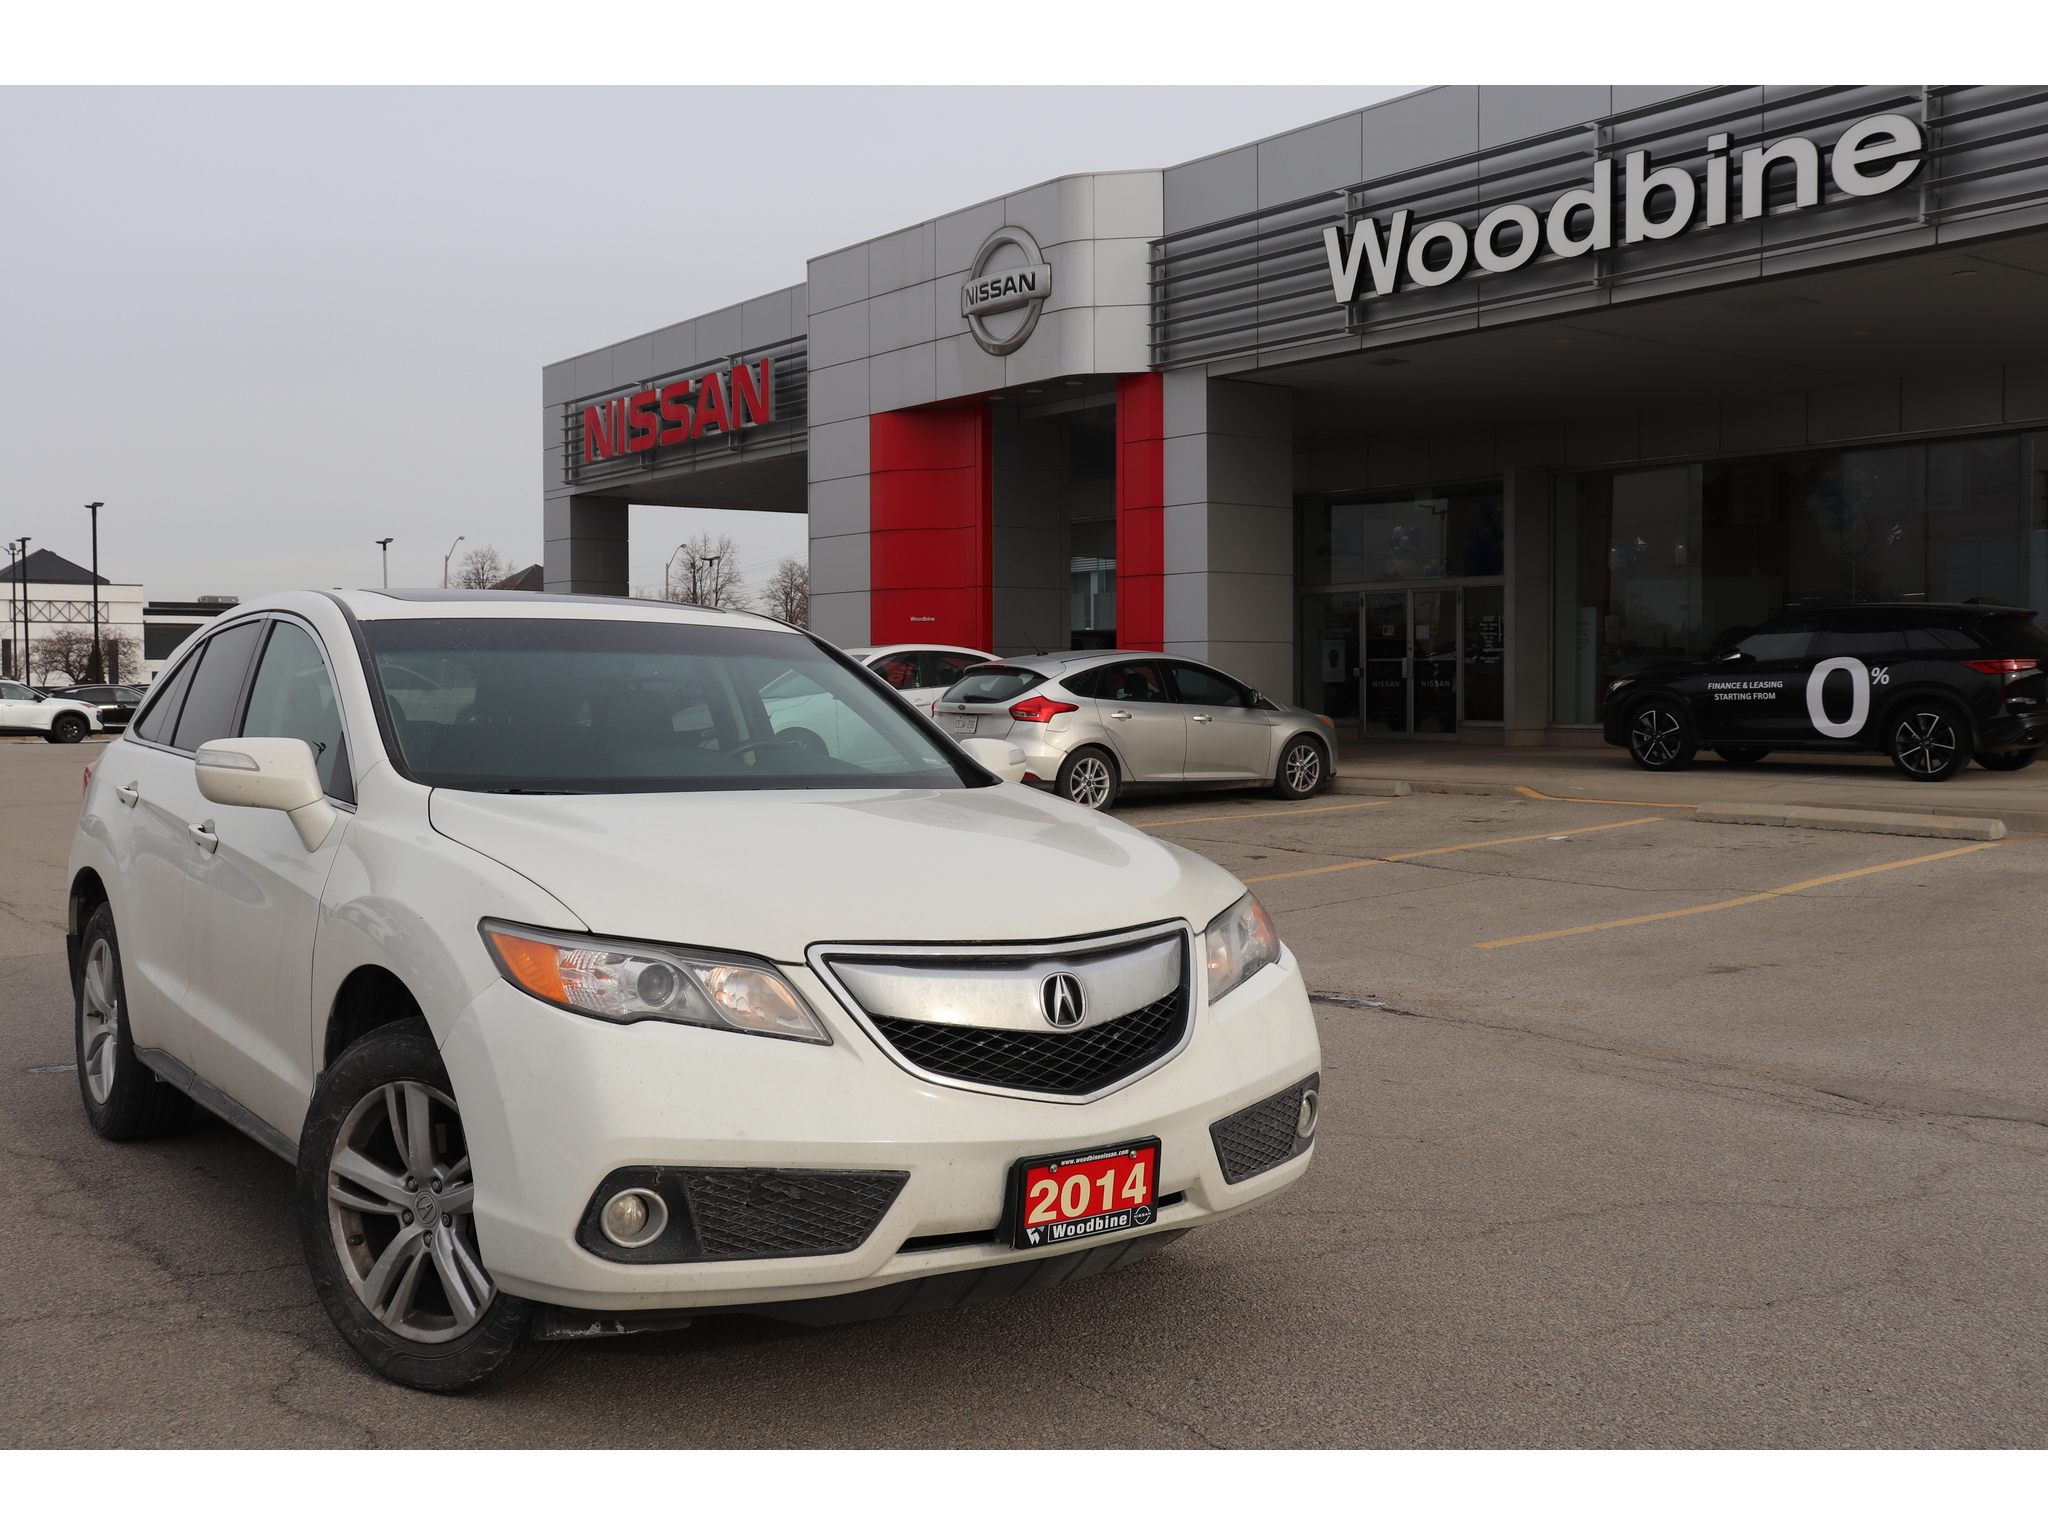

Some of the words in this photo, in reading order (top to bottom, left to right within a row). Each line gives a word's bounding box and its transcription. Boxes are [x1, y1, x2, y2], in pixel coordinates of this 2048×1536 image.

[1322, 112, 1928, 303] Woodbine
[965, 271, 1036, 308] NISSAN
[584, 358, 776, 463] NISSAN
[1372, 680, 1400, 688] NISSAN
[1421, 680, 1450, 688] NISSAN
[1707, 682, 1741, 690] FINANCE
[1749, 681, 1783, 689] LEASING
[1714, 692, 1752, 701] STARTING
[1753, 692, 1776, 700] FROM
[1060, 1149, 1130, 1166] www.woodbinenissan.com
[1028, 1162, 1147, 1224] 2014
[1053, 1213, 1128, 1239] Woodbine
[1133, 1211, 1152, 1219] NISSAN
